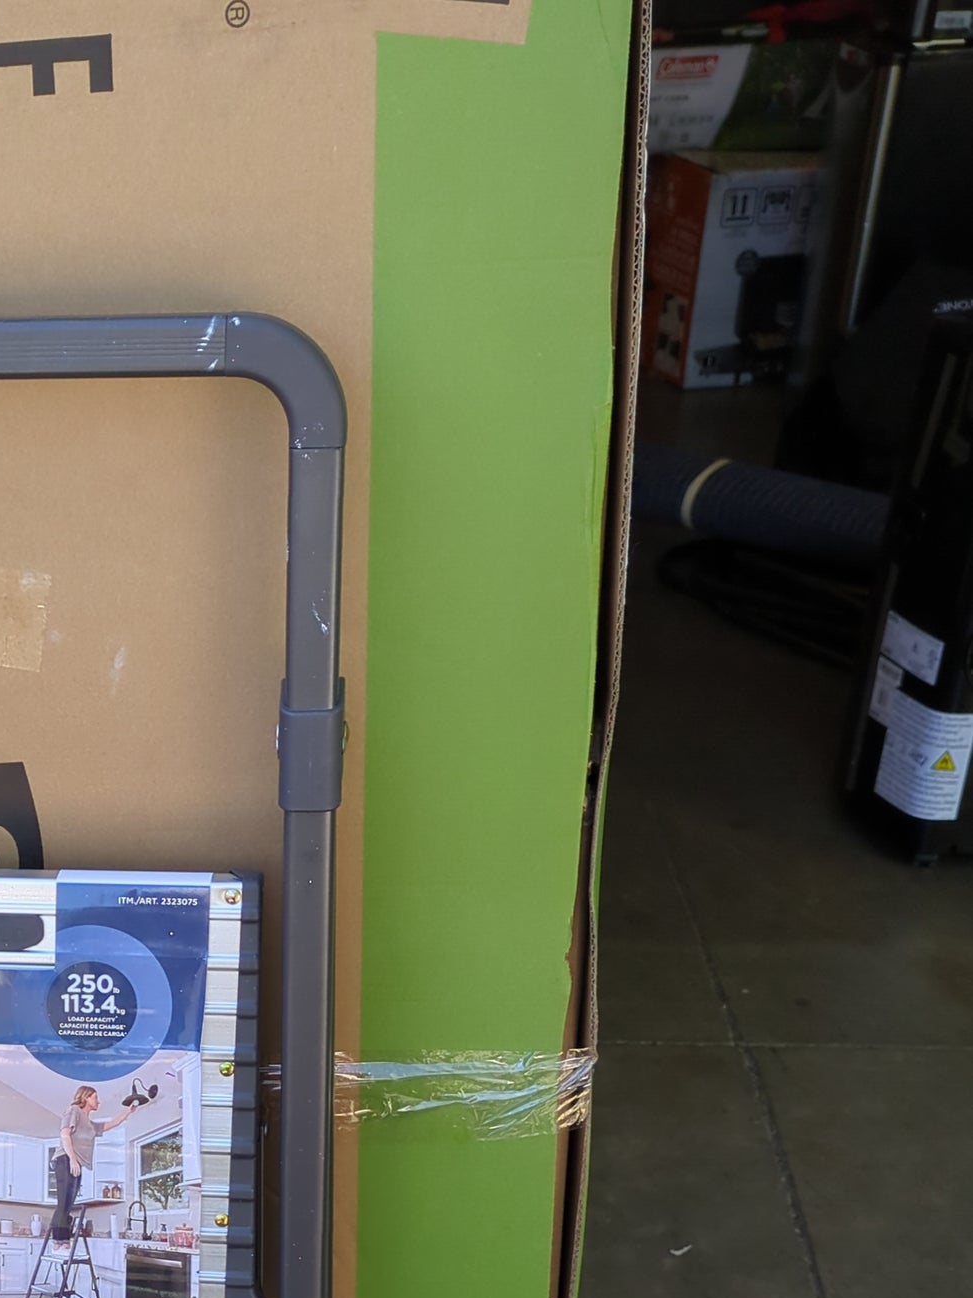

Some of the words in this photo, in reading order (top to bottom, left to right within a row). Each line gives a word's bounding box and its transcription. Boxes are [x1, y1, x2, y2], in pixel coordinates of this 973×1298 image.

[161, 898, 198, 906] 2323075
[67, 974, 114, 994] 250
[61, 994, 117, 1014] 113.4
